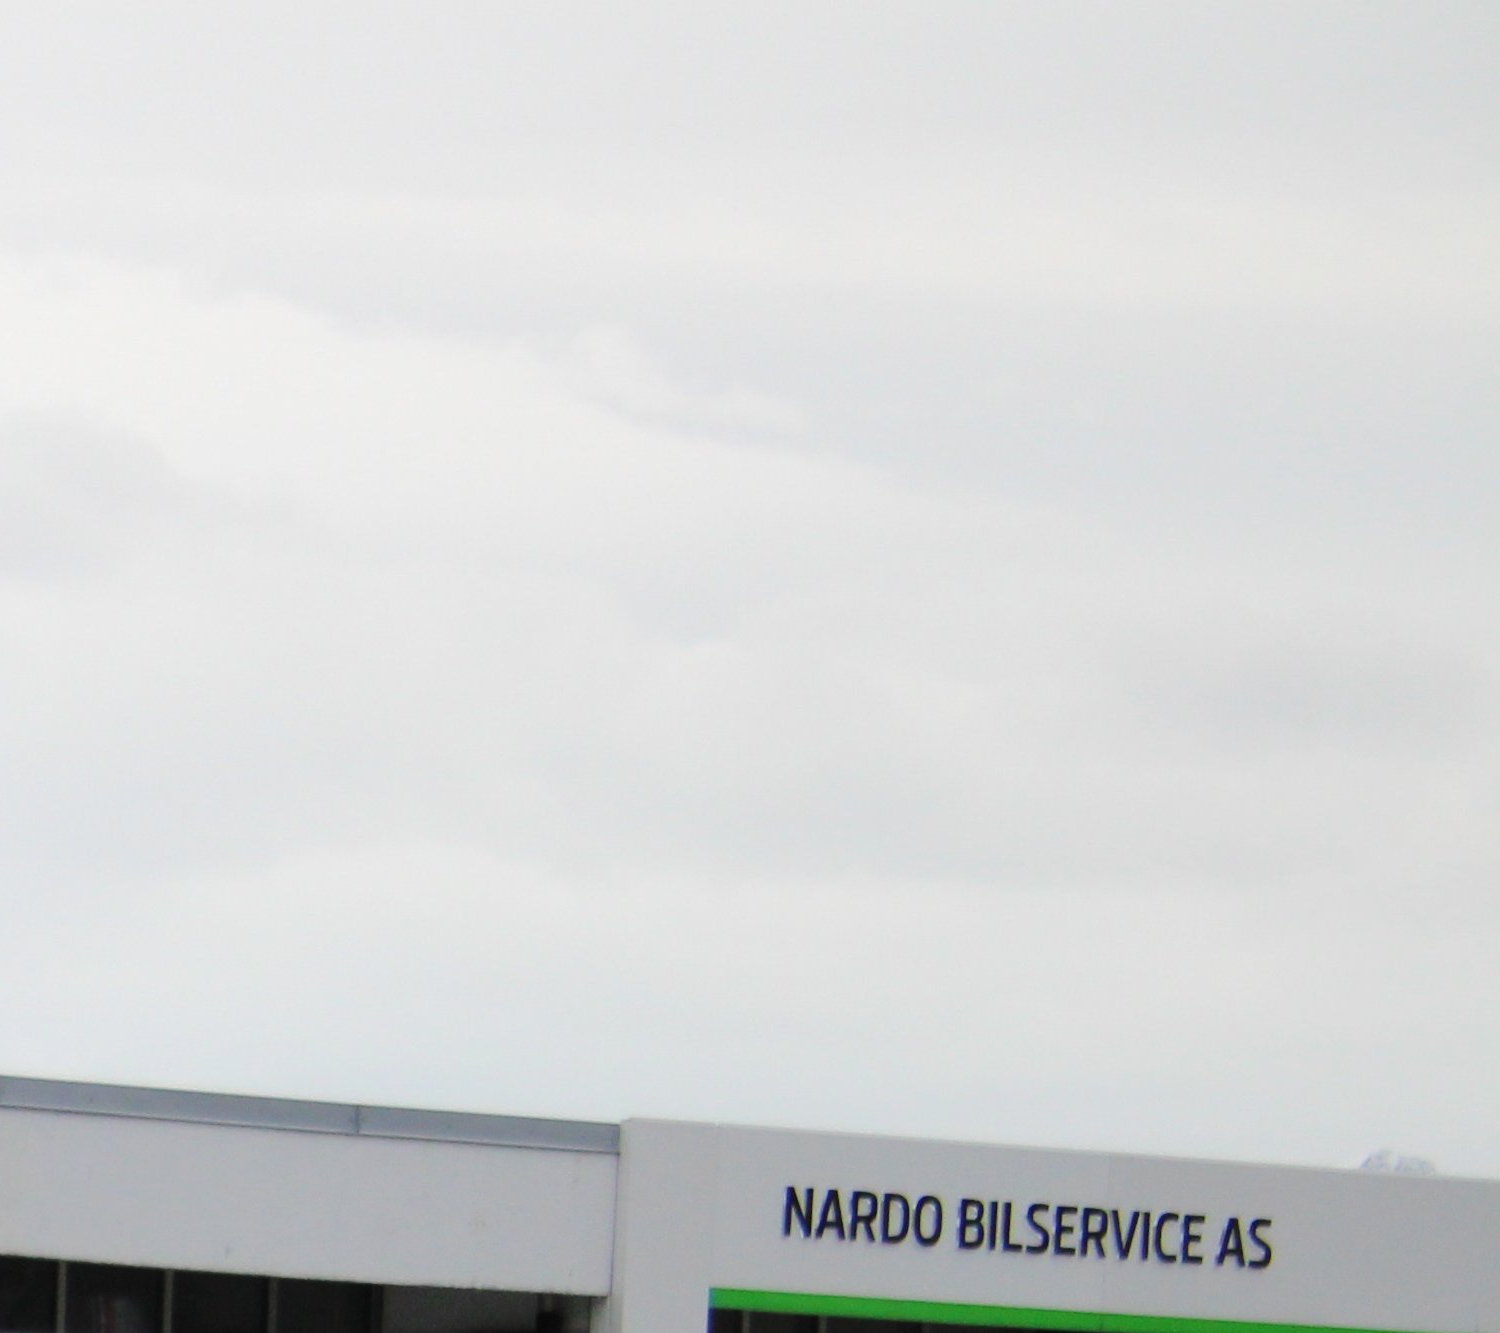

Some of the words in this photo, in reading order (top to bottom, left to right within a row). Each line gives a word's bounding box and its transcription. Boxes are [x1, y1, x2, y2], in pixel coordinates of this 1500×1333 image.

[783, 1185, 943, 1248] NARDO
[957, 1197, 1206, 1266] BILSERVICE
[1215, 1216, 1273, 1270] AS
